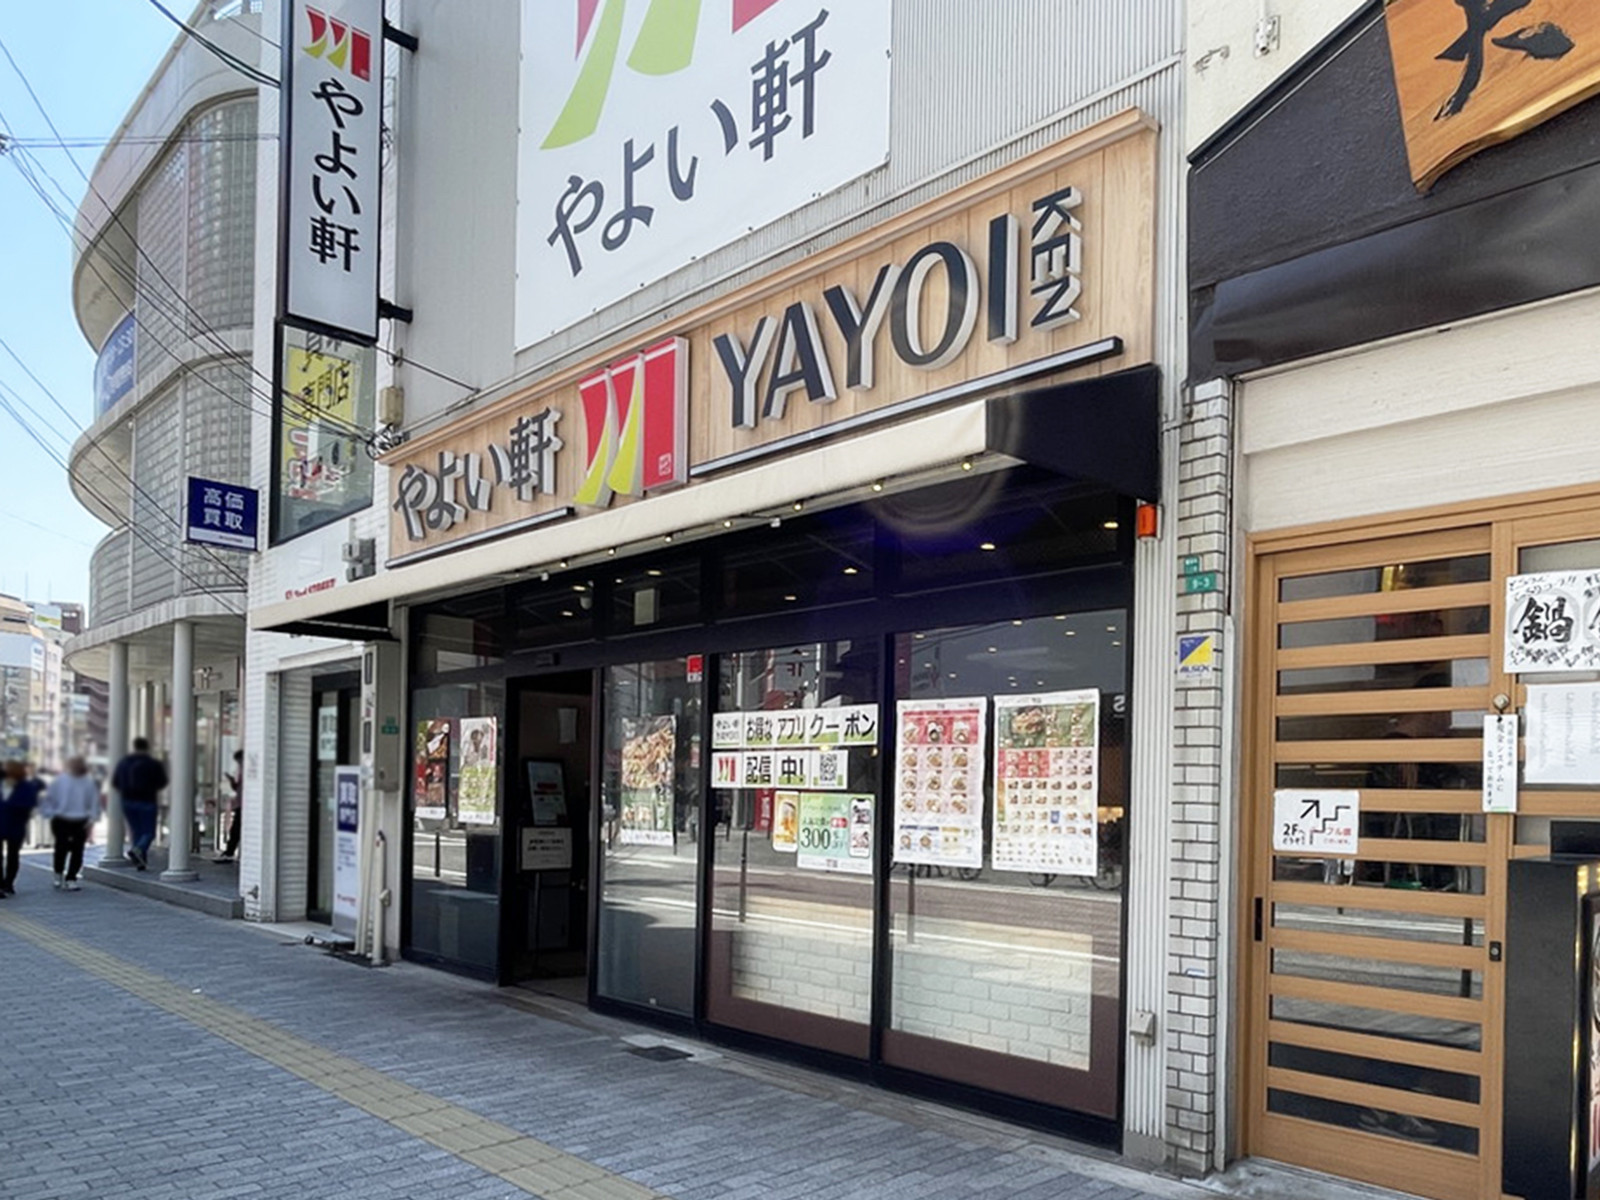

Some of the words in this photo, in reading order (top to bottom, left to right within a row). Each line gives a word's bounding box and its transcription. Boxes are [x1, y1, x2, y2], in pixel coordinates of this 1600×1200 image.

[309, 78, 363, 273] やよい軒
[547, 9, 832, 278] やよい軒
[712, 213, 1020, 430] YAYOI
[1031, 186, 1083, 331] KEN
[203, 486, 245, 511] 高価
[203, 508, 243, 531] 買取
[393, 407, 563, 541] やよい軒
[1512, 596, 1574, 644] 鍋
[800, 827, 831, 849] 300
